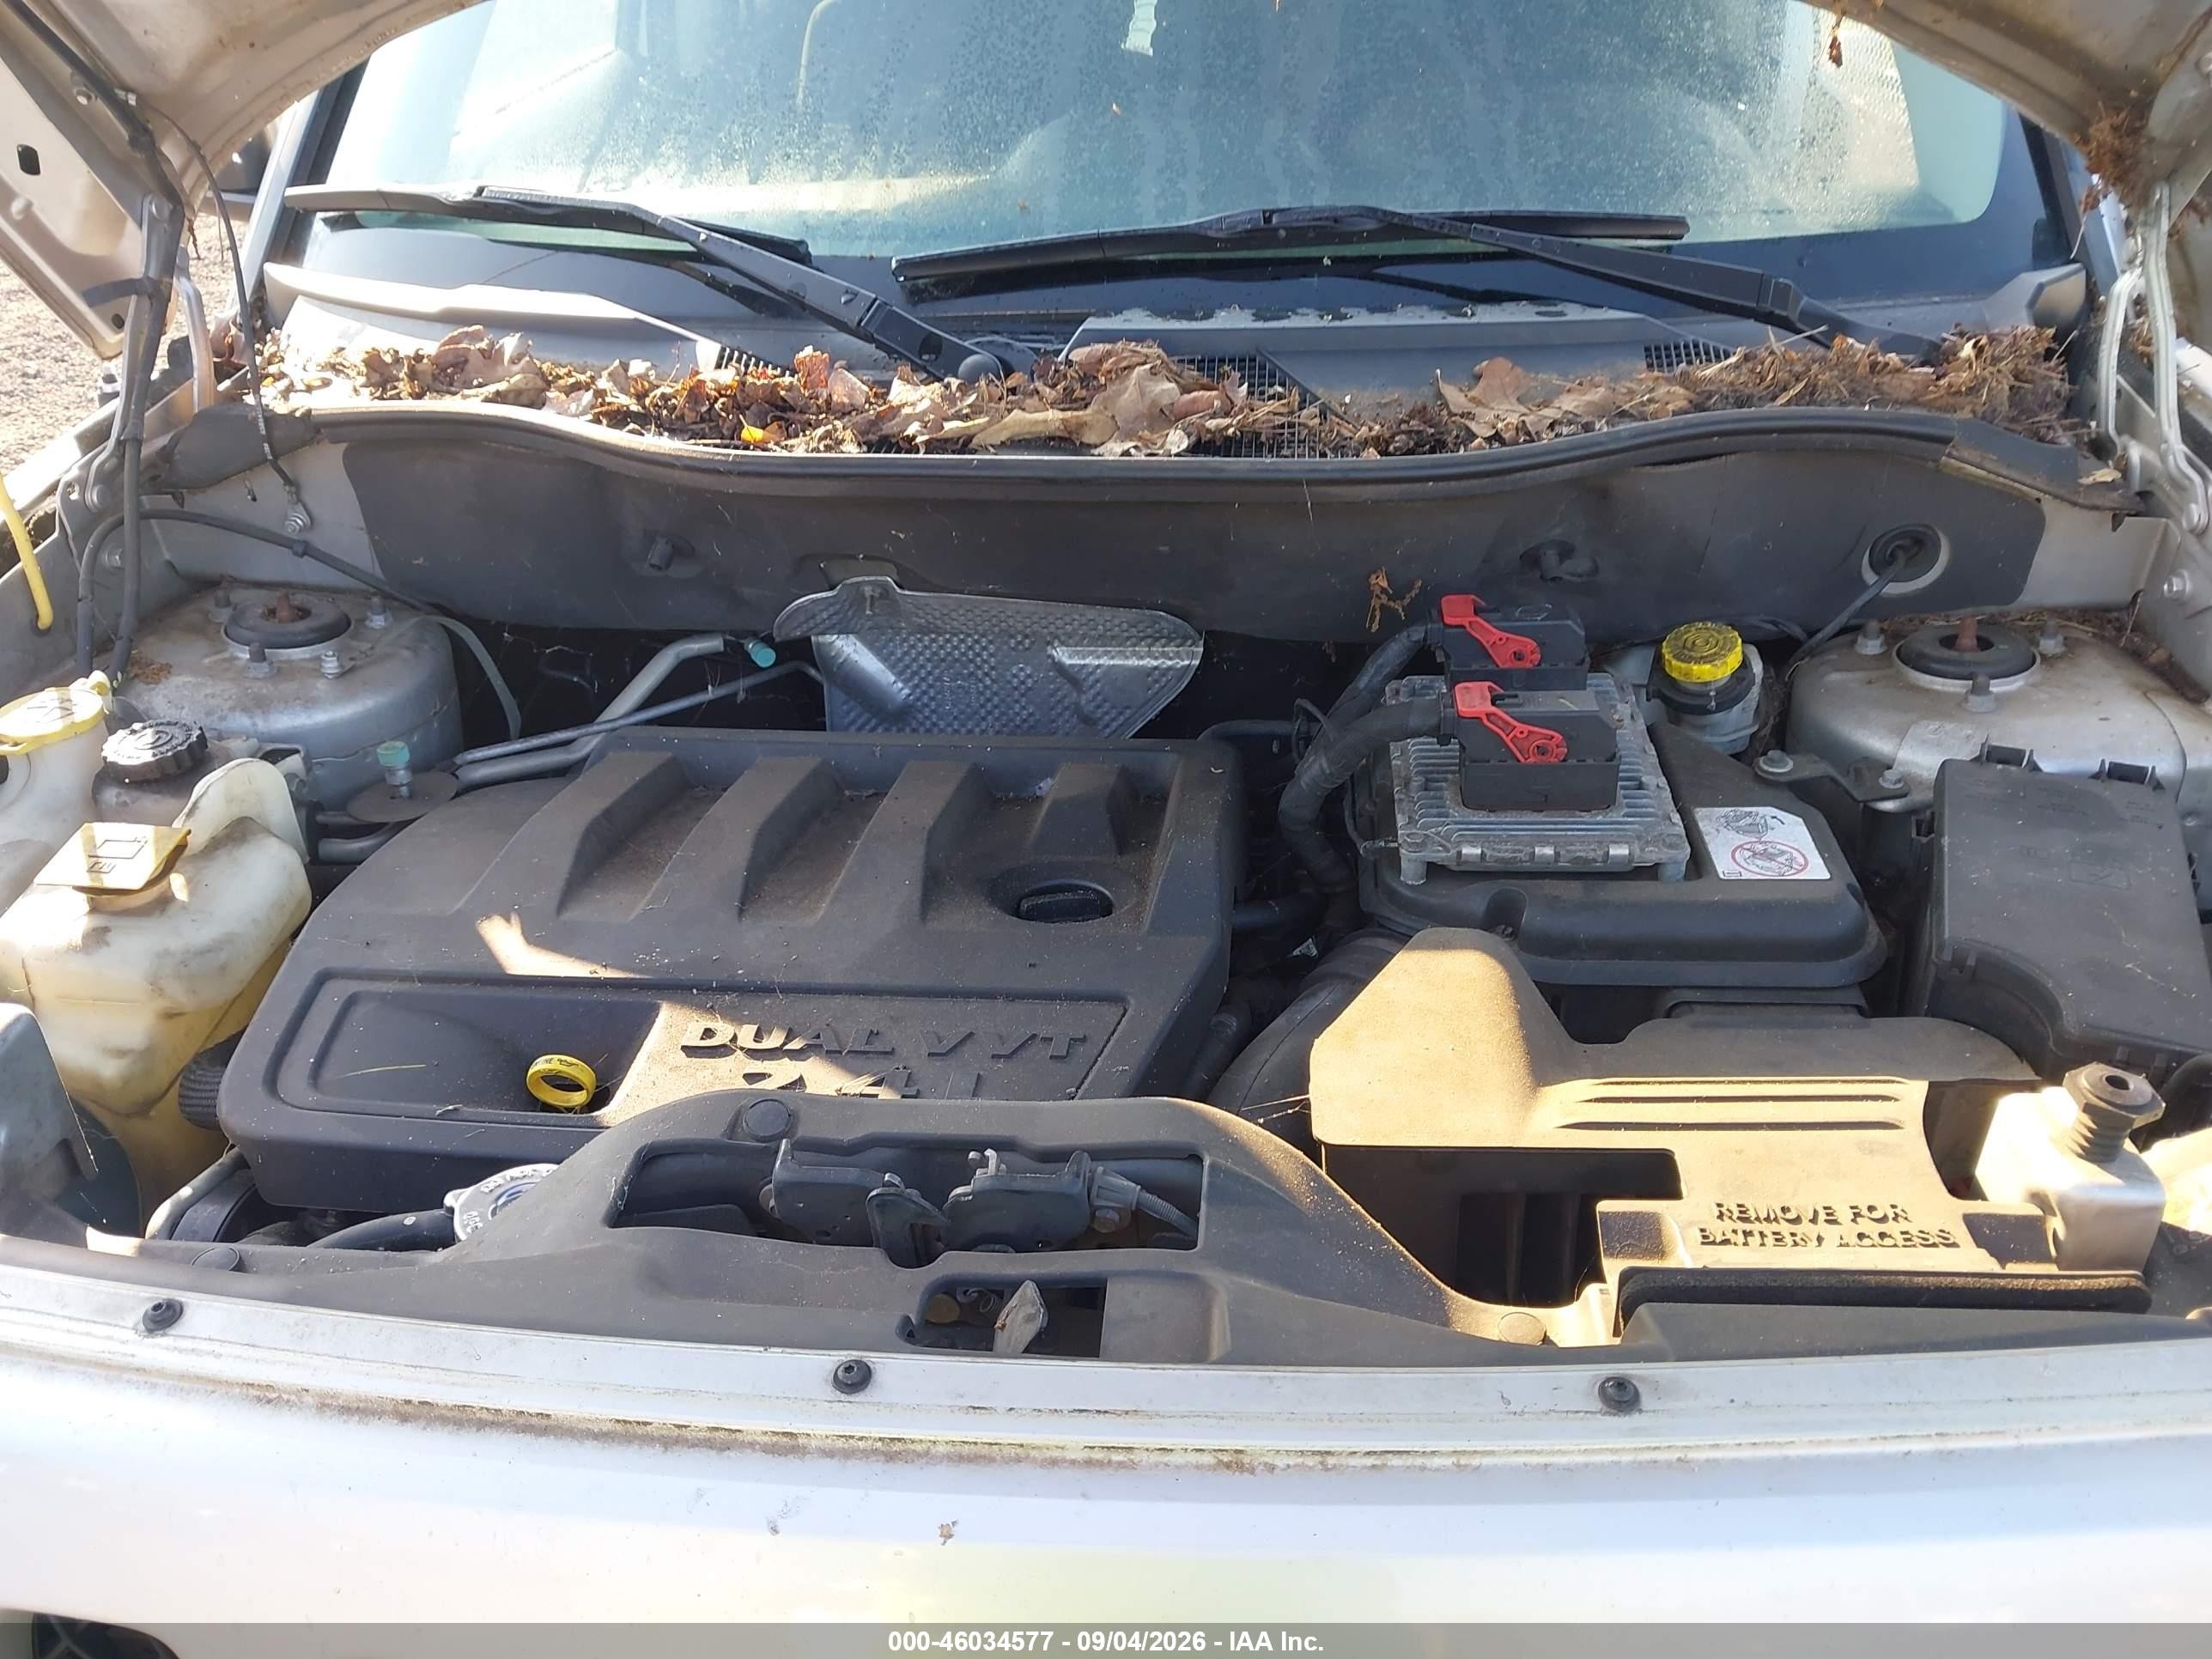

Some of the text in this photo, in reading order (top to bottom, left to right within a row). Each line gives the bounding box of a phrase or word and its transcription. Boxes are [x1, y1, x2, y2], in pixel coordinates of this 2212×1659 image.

[681, 1024, 895, 1055] DUAL
[742, 1067, 981, 1100] 24
[1714, 1202, 1913, 1225] REMOVE FOR
[1696, 1227, 1961, 1249] BATTERY ACCESS
